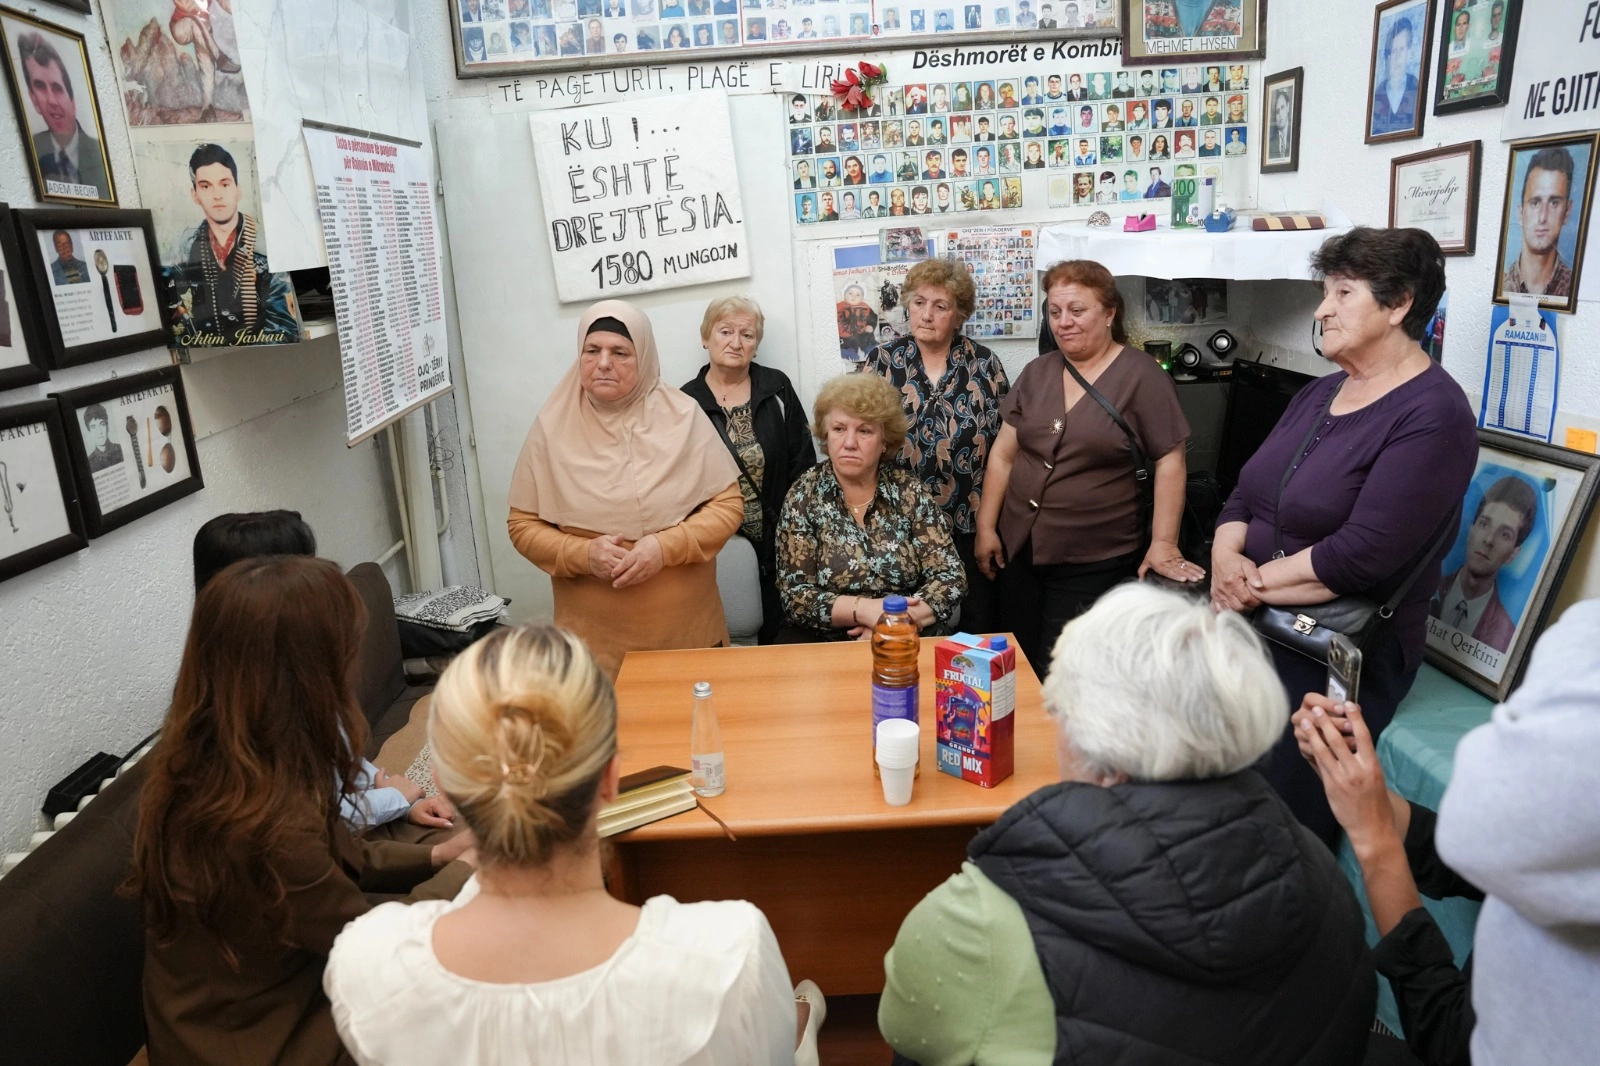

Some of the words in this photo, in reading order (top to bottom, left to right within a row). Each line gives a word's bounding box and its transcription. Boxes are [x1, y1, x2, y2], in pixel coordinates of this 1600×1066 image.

[912, 44, 1027, 69] Dëshmorët
[1033, 46, 1045, 60] e
[1146, 38, 1193, 54] MEHMET
[498, 80, 523, 102] TË
[688, 62, 749, 90] PLAGË
[770, 63, 782, 86] E
[1523, 80, 1550, 119] NE
[561, 117, 612, 155] KU
[568, 147, 683, 203] ËSHTË
[1174, 178, 1196, 196] 100
[48, 183, 71, 194] ADEM
[1404, 176, 1460, 206] Mirënjohje
[89, 231, 133, 241] ARTEFAKTE
[591, 250, 653, 289] 1580
[664, 242, 738, 274] MUNGOJN
[181, 330, 225, 346] Artim
[229, 327, 285, 347] Jashari
[1505, 330, 1539, 341] RAMAZAN
[1451, 632, 1501, 668] Qerkini
[943, 669, 984, 689] FRUCTAL
[949, 742, 975, 755] GRANDE
[942, 748, 961, 767] RED
[962, 755, 982, 775] MIX
